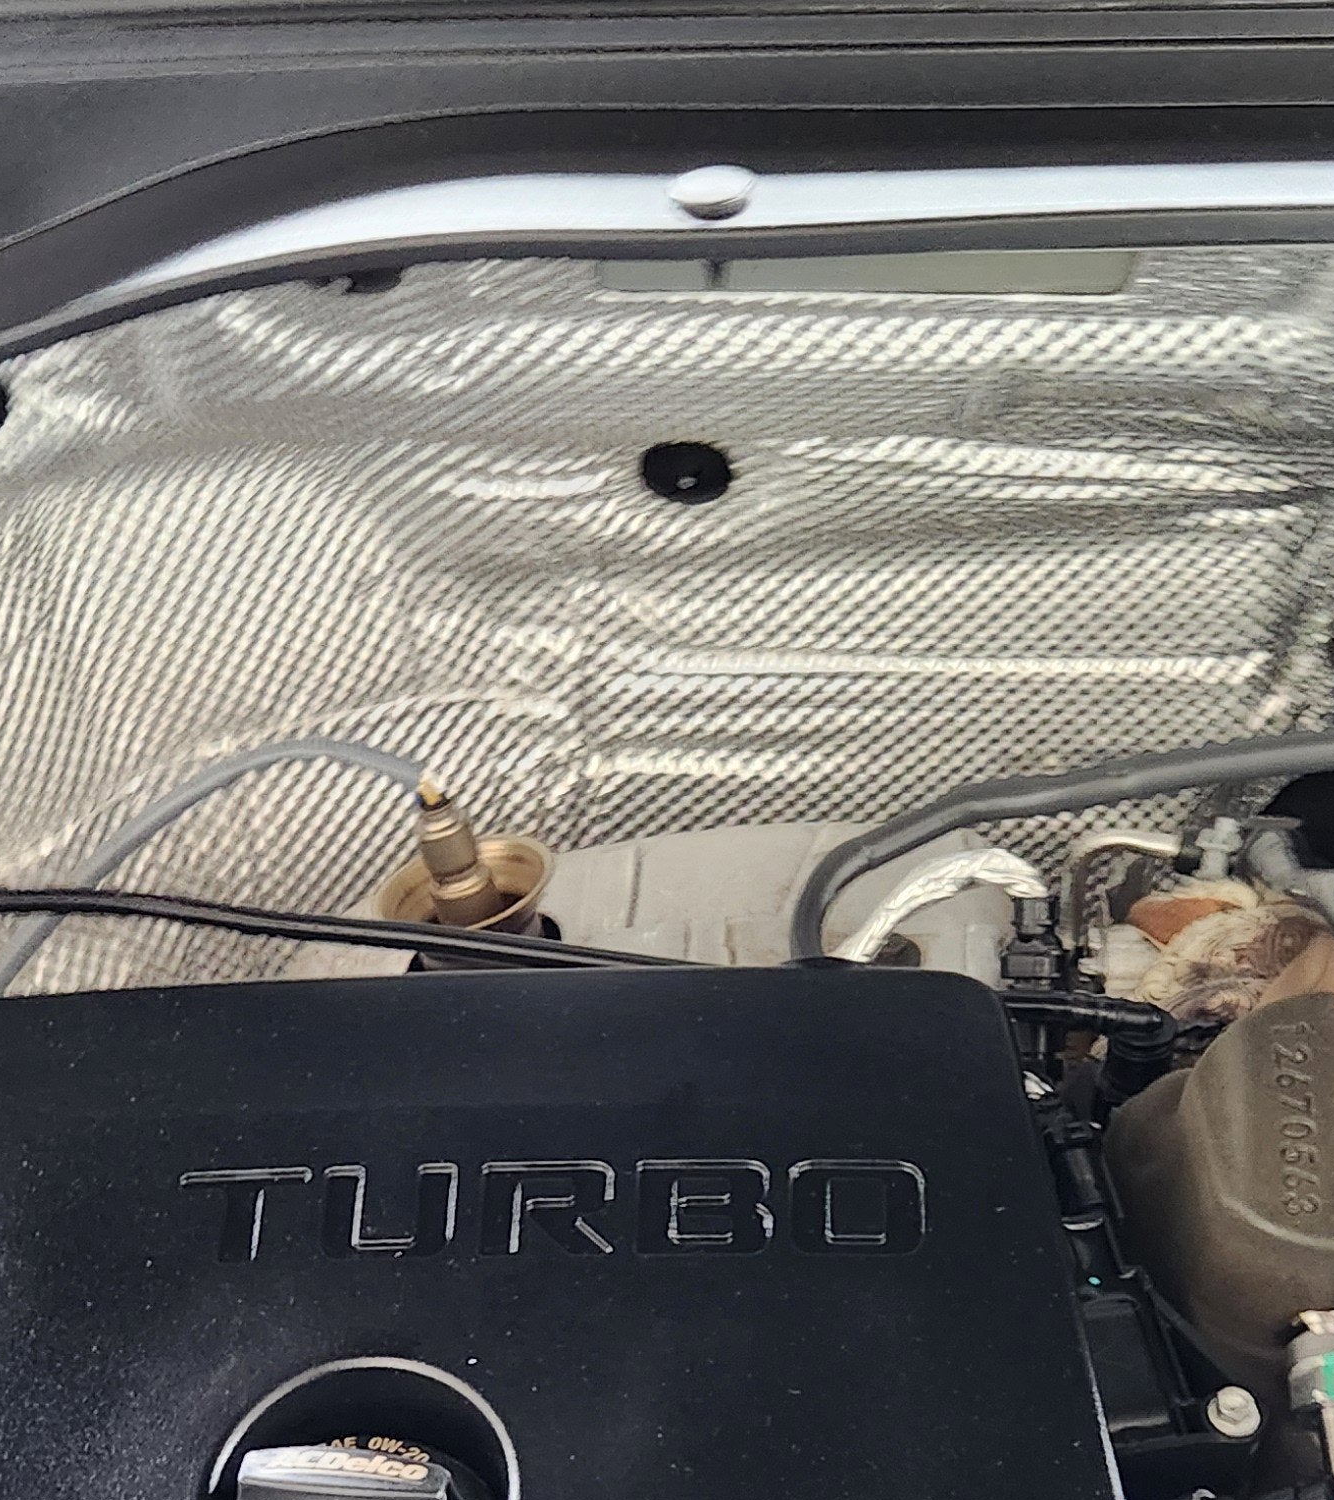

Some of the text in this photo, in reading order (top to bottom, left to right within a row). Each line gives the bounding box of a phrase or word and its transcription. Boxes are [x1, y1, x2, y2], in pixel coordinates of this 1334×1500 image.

[179, 1158, 927, 1262] TURBO
[267, 1449, 429, 1481] ACDelco
[367, 1436, 430, 1463] 0W-20
